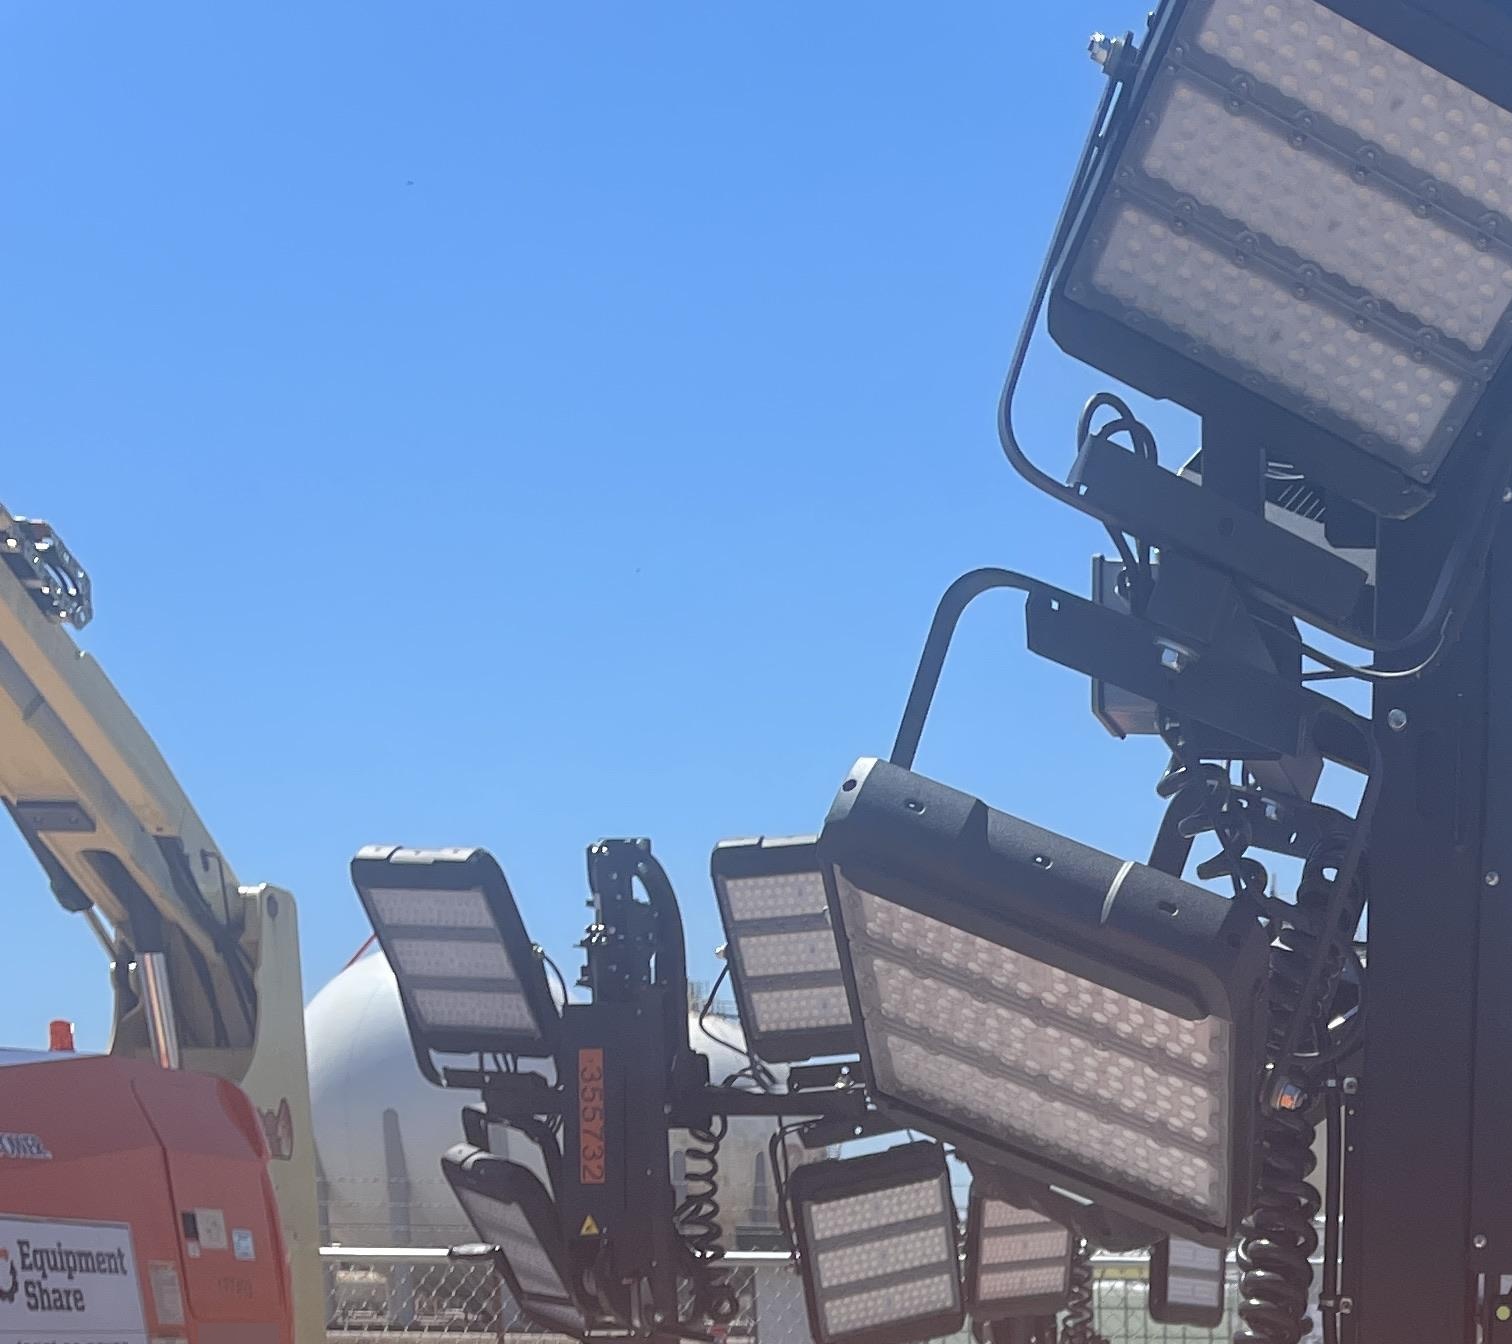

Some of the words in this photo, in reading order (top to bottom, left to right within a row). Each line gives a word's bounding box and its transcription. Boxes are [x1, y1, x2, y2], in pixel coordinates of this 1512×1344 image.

[581, 1066, 603, 1180] 355732
[17, 1238, 128, 1280] Equipment
[24, 1279, 85, 1312] Share
